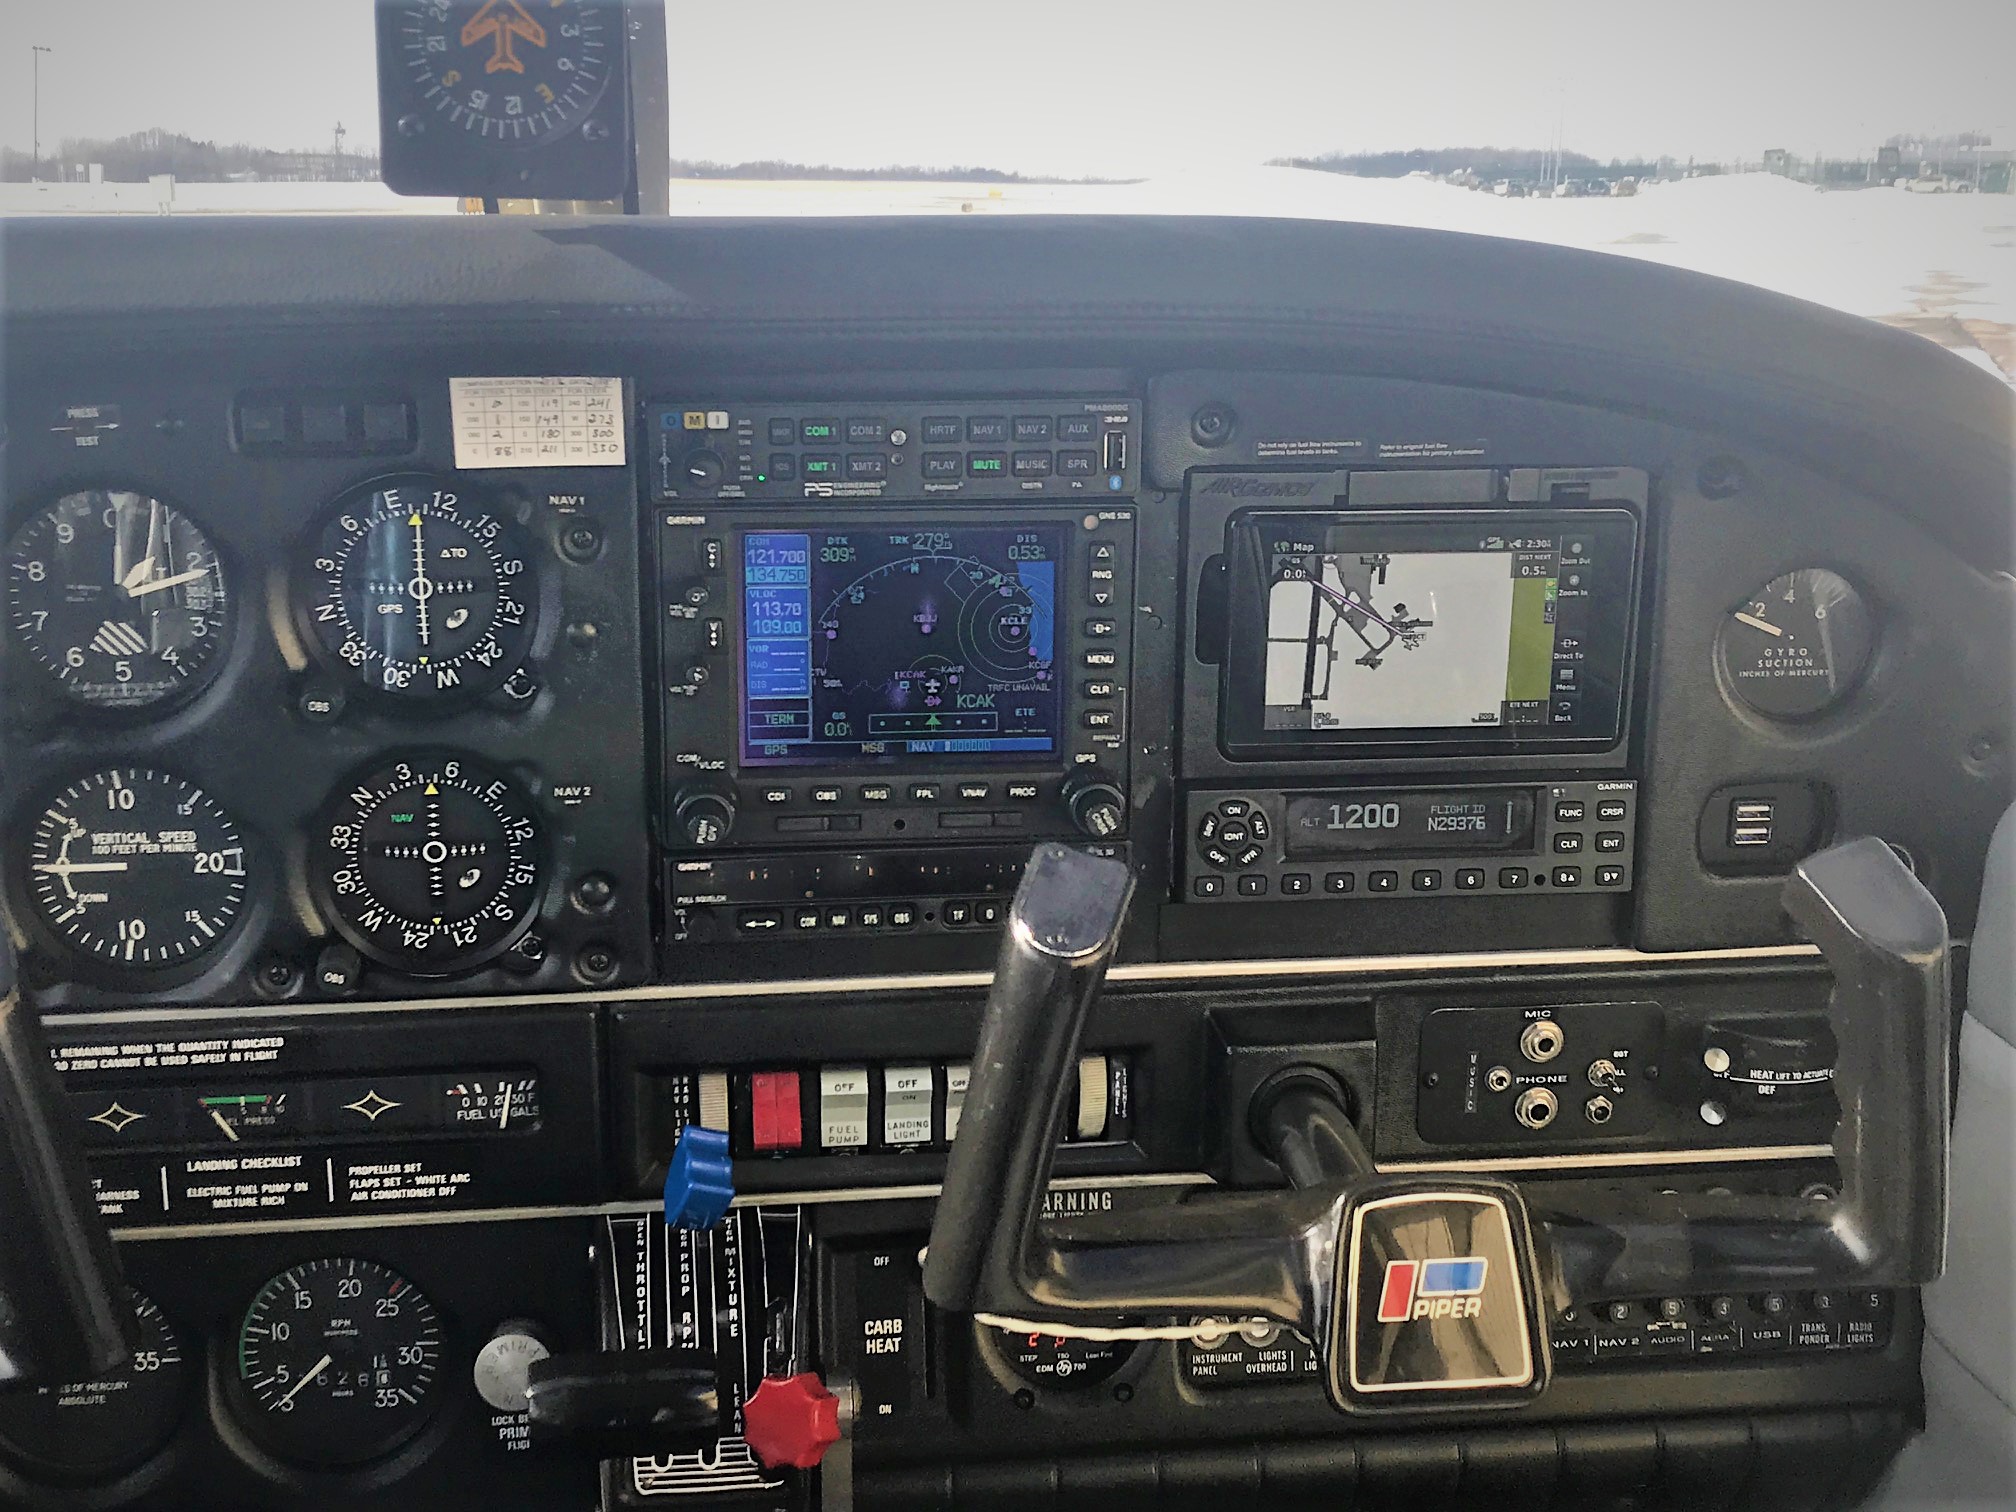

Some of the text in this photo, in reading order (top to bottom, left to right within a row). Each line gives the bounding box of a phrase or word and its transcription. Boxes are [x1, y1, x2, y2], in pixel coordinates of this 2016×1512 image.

[805, 427, 829, 436] COM
[851, 426, 874, 435] COM
[929, 425, 957, 434] HRTF
[1018, 424, 1047, 434] NAV 2
[1068, 424, 1089, 433] AUX
[807, 462, 828, 471] XMT
[852, 462, 873, 471] XMT
[930, 460, 956, 470] PLAY
[972, 460, 1001, 470] MUTE
[1016, 459, 1047, 469] MUSIC
[1067, 459, 1088, 469] SPR
[383, 489, 401, 509] E
[433, 491, 457, 511] 12
[549, 496, 577, 505] NAV
[340, 515, 358, 531] 6
[475, 514, 501, 538] 15
[57, 524, 75, 544] 9
[1293, 543, 1314, 553] Map
[748, 549, 806, 564] 121.700
[315, 558, 335, 572] 3
[503, 560, 523, 575] S
[28, 561, 46, 582] 8
[749, 568, 806, 582] 134.750
[1092, 570, 1113, 579] RNG
[1558, 589, 1579, 597] Zoom
[1783, 589, 1795, 604] 4
[315, 604, 338, 622] N
[377, 604, 403, 614] GPS
[503, 601, 525, 625] 21
[752, 602, 802, 616] 113.70
[1755, 602, 1766, 618] 2
[31, 611, 49, 631] 7
[189, 616, 208, 637] 3
[752, 619, 802, 634] 109.00
[66, 647, 84, 667] 6
[161, 646, 179, 665] 4
[339, 641, 367, 667] 33
[477, 641, 503, 667] 24
[1554, 652, 1584, 660] Direct To
[1764, 648, 1808, 657] GYRO
[1087, 655, 1114, 664] MENU
[1758, 659, 1814, 668] SUCTION
[115, 661, 133, 681] 5
[1739, 670, 1770, 678] INCHES
[1789, 669, 1829, 677] MERCURY
[383, 667, 411, 688] 30
[437, 669, 460, 688] W
[988, 683, 1051, 692] TRFC UNAVAIL
[1090, 685, 1109, 695] CLR
[957, 693, 995, 708] KCAK
[764, 714, 795, 724] TERM
[1090, 715, 1110, 725] ENT
[764, 745, 788, 755] GPS
[861, 743, 885, 753] MSG
[1075, 753, 1097, 763] GPS
[395, 764, 411, 780] 3
[445, 762, 459, 778] 6
[487, 780, 508, 800] E
[554, 787, 592, 796] NAV 2
[1009, 787, 1036, 796] PROC
[1597, 783, 1633, 791] GARMIN
[108, 788, 135, 810] 10
[351, 786, 373, 807] N
[916, 789, 934, 799] FPL
[177, 804, 193, 815] 15
[1227, 806, 1241, 815] ON
[1431, 805, 1486, 815] FLIGHT ID
[1560, 808, 1582, 817] FUNC
[1601, 808, 1624, 816] CRSR
[1301, 803, 1400, 829] ALT 1200
[512, 817, 534, 841] 12
[91, 831, 197, 844] VERTICAL SPEED
[330, 825, 351, 850] 33
[1224, 832, 1244, 841] IDNT
[1561, 840, 1577, 849] CLR
[1603, 839, 1619, 847] ENT
[194, 852, 224, 873] 20
[1209, 851, 1225, 864] OFF
[1241, 850, 1258, 864] VFR
[515, 863, 536, 885] 15
[1467, 876, 1475, 884] 6
[1511, 875, 1519, 884] 7
[333, 870, 356, 894] 30
[1206, 883, 1214, 891] 0
[1293, 881, 1301, 890] 2
[1336, 880, 1345, 889] 3
[1380, 879, 1388, 887] 4
[1424, 877, 1431, 886] 5
[185, 911, 201, 922] 15
[495, 904, 514, 921] S
[118, 919, 146, 940] 10
[403, 930, 430, 949] 24
[454, 926, 477, 947] 21
[1525, 1010, 1551, 1018] MIC
[191, 1050, 279, 1064] SAFELY FLIGHT
[1515, 1075, 1568, 1084] PHONE
[1750, 1069, 1774, 1079] HEAT
[835, 1083, 854, 1092] OFF
[898, 1079, 917, 1089] OFF
[1758, 1085, 1776, 1094] DEF
[457, 1109, 486, 1120] FUEL
[829, 1125, 858, 1134] FUEL
[887, 1120, 929, 1130] LANDING
[829, 1136, 859, 1144] PUMP
[894, 1130, 921, 1139] LIGHT
[187, 1155, 302, 1172] LANDING CHECKLIST
[349, 1163, 422, 1176] PROPELLER SET
[415, 1173, 470, 1185] WHITE ARC
[187, 1182, 309, 1198] ELECTRIC FUEL PUMP ON
[1041, 1192, 1112, 1211] ARNING
[873, 1256, 890, 1267] OFF
[338, 1279, 361, 1298] 20
[725, 1247, 739, 1337] MIXTURE
[295, 1291, 312, 1310] 15
[376, 1300, 399, 1317] 25
[1413, 1297, 1482, 1320] PIPER
[271, 1323, 290, 1341] 10
[865, 1319, 902, 1336] CARB
[866, 1337, 902, 1354] HEAT
[1600, 1338, 1627, 1347] NAV
[1651, 1336, 1685, 1344] AUDIO
[134, 1352, 160, 1371] 35
[399, 1346, 423, 1365] 30
[1192, 1350, 1287, 1364] INSTRUMENT LIGHTS
[277, 1365, 289, 1383] 5
[1192, 1362, 1287, 1376] PANEL OVERHEAD
[375, 1389, 399, 1408] 35
[879, 1405, 892, 1415] ON
